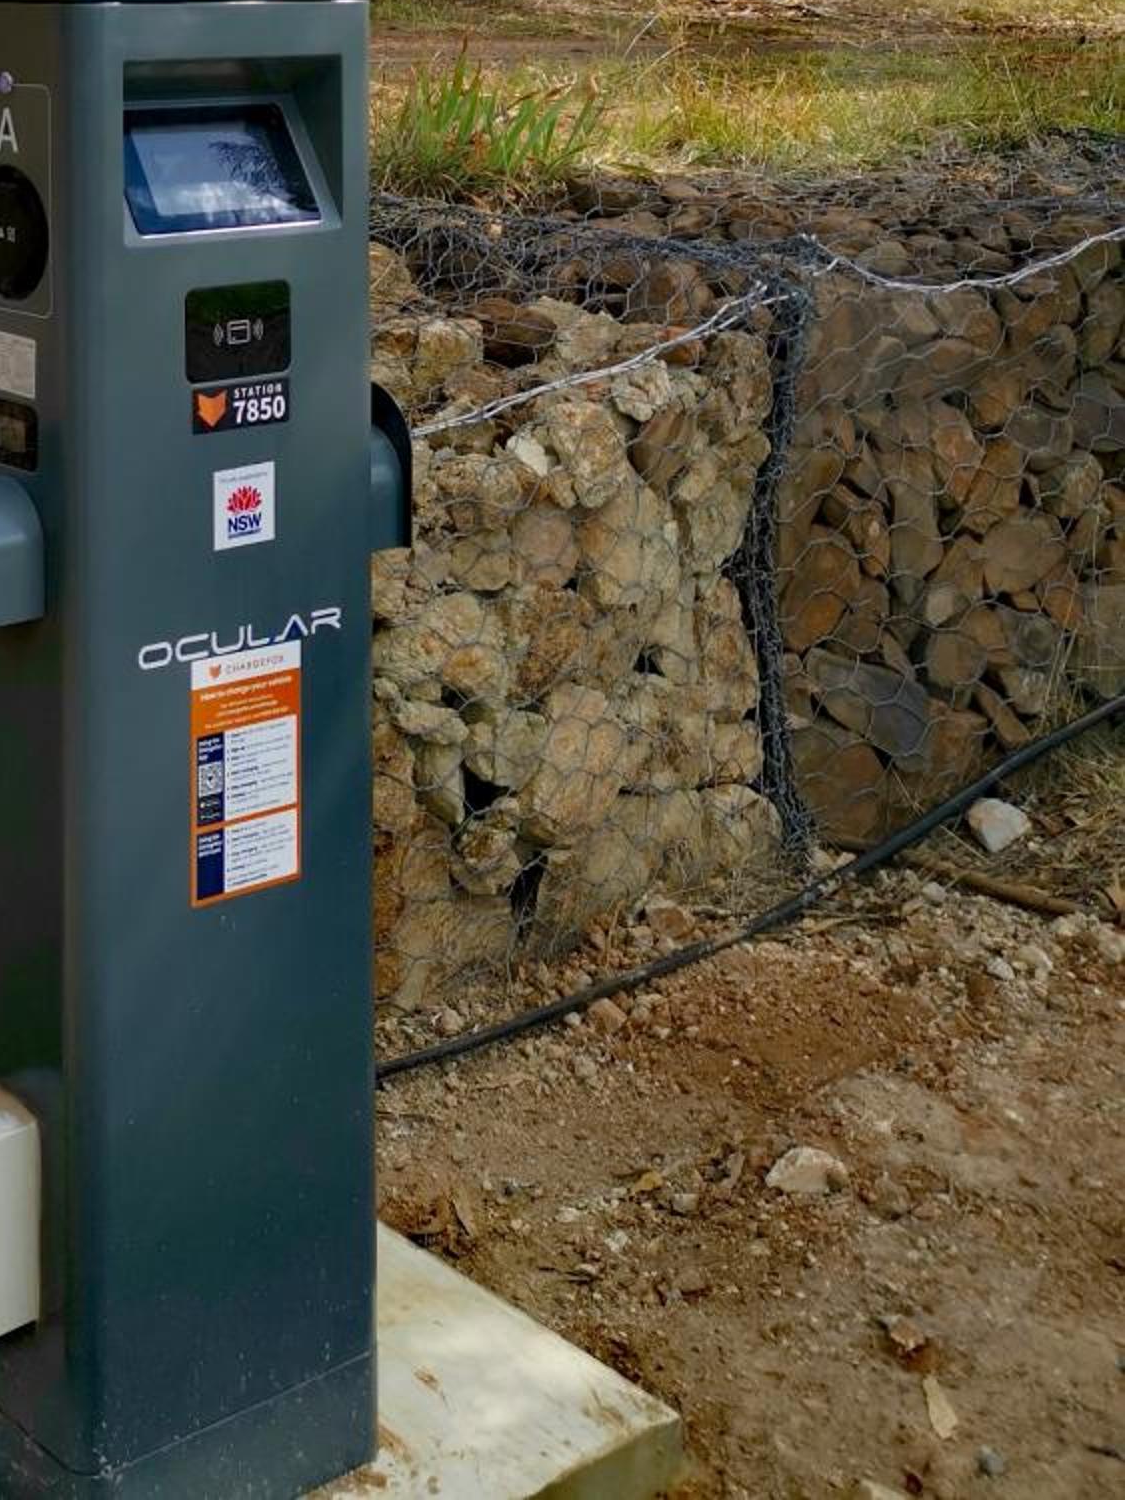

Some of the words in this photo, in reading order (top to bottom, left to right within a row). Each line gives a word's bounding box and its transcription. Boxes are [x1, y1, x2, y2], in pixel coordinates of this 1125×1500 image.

[233, 395, 286, 424] 7850
[228, 512, 262, 533] NSW
[138, 607, 342, 671] OCULAR
